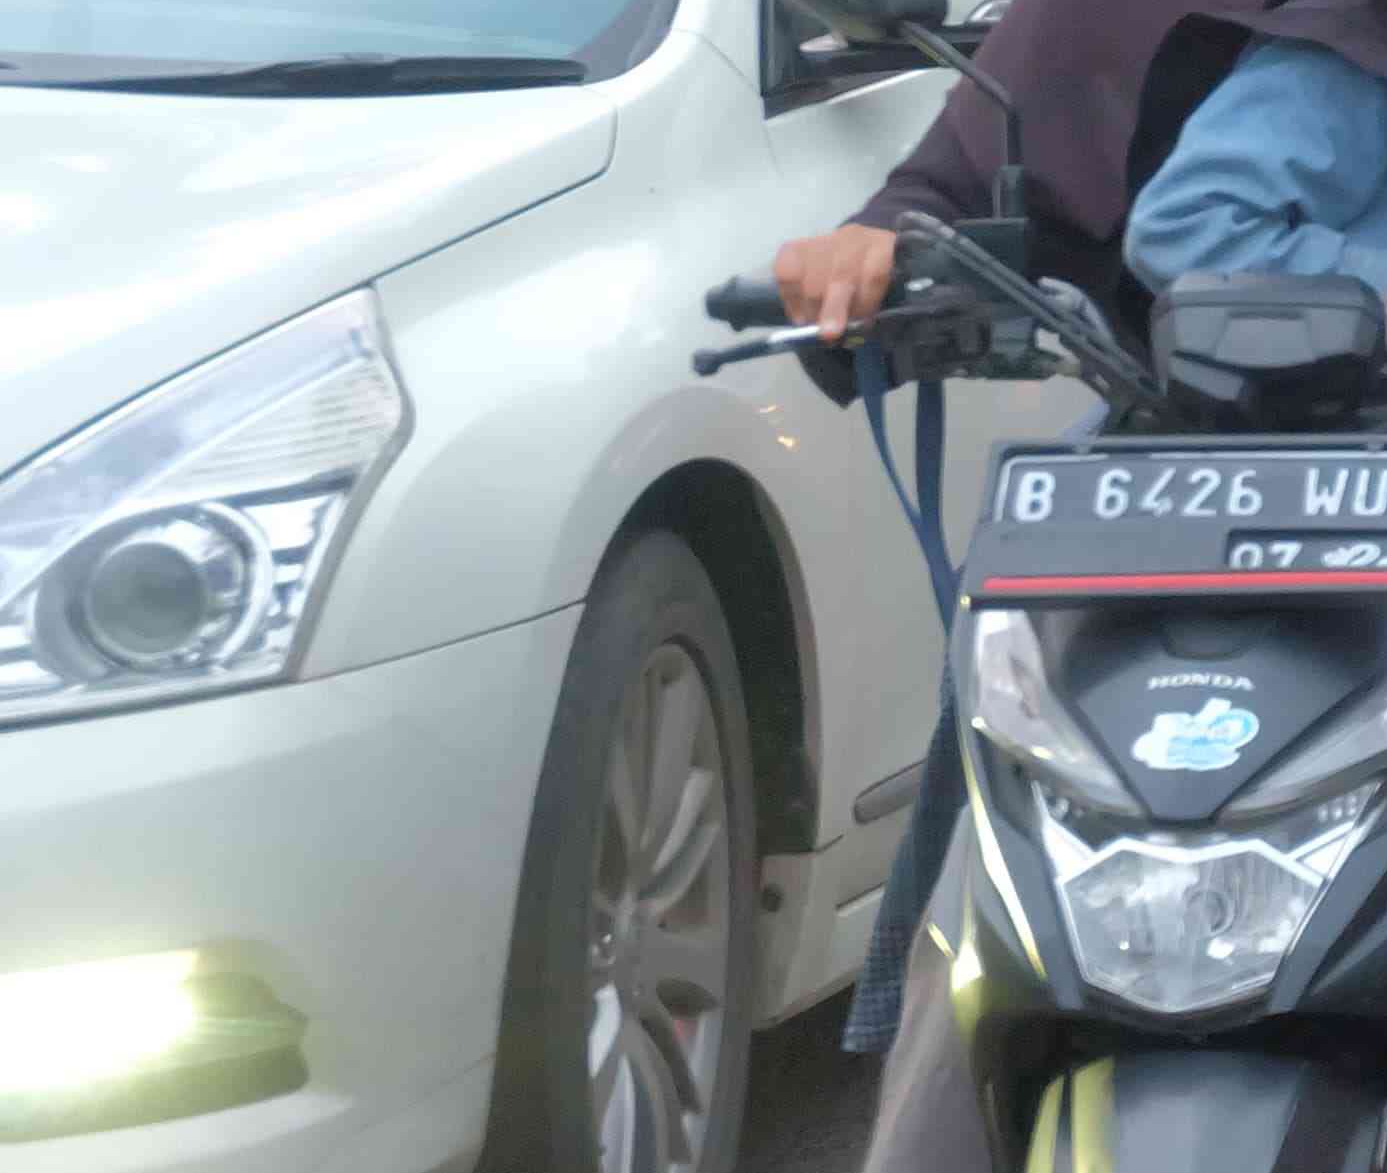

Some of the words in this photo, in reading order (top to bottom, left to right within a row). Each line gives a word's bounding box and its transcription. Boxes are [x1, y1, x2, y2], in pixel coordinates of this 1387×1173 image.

[1014, 470, 1057, 522] B
[1093, 467, 1263, 520] 6426
[1147, 671, 1256, 691] HONDA
